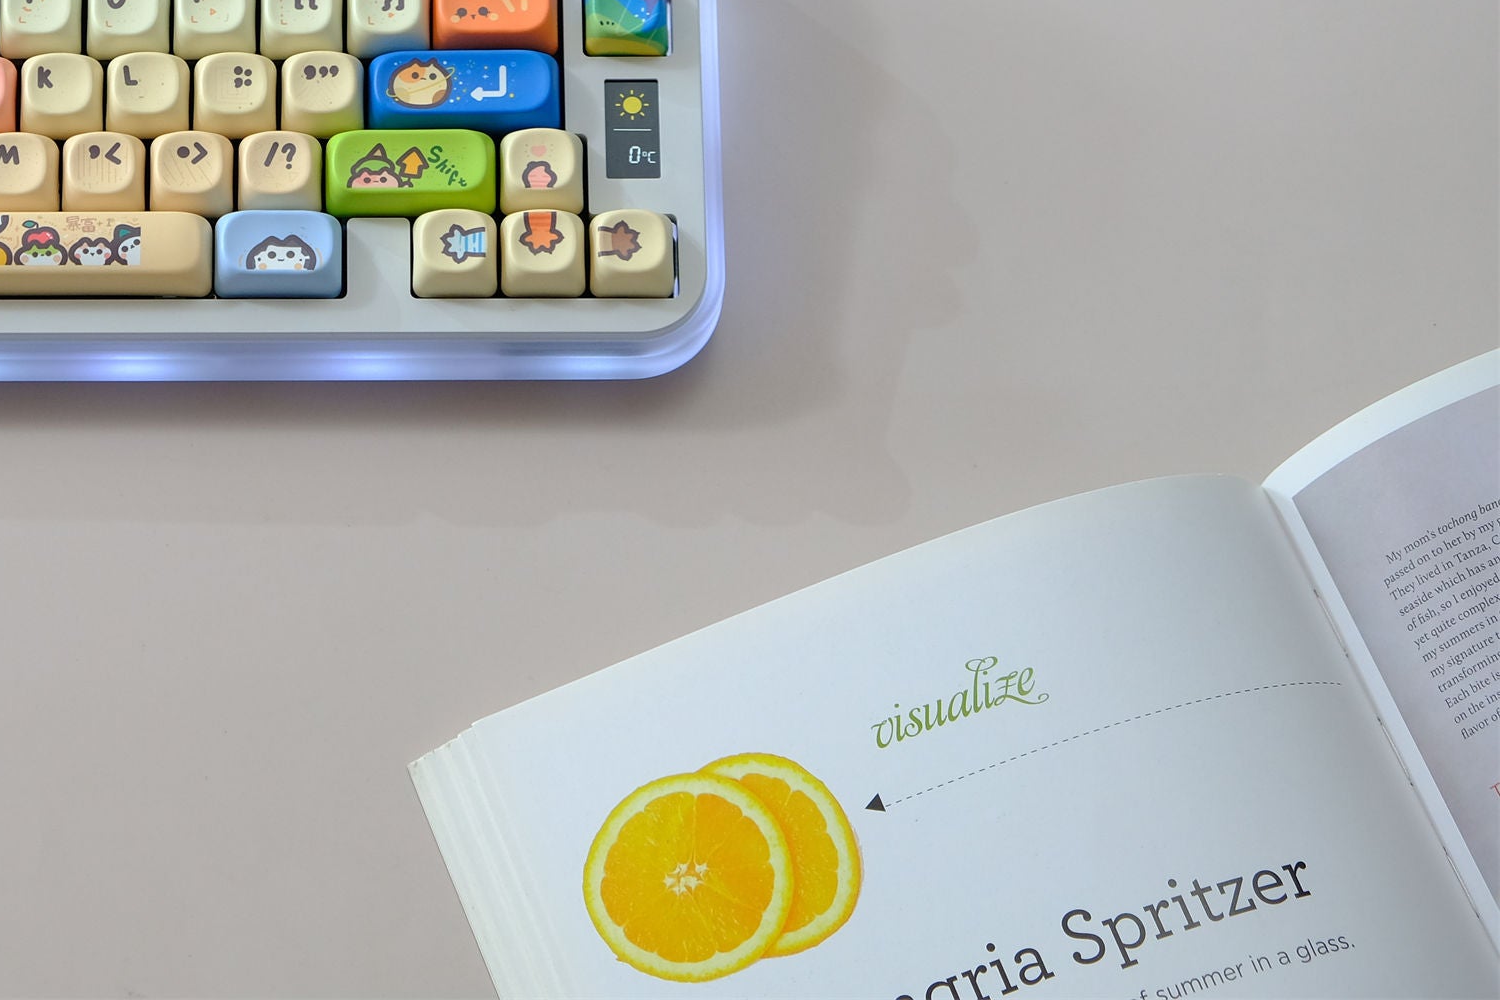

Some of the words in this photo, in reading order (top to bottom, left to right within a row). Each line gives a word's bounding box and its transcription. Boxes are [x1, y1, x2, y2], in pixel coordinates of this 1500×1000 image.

[37, 66, 53, 88] K
[124, 65, 138, 86] L
[427, 145, 468, 188] Shift
[1383, 559, 1416, 589] passed
[1417, 553, 1431, 566] on
[1431, 547, 1443, 557] to
[1443, 536, 1462, 551] her
[1461, 529, 1477, 541] by
[1478, 520, 1495, 534] my
[1385, 550, 1402, 564] My
[1404, 530, 1437, 553] mom's
[1437, 510, 1478, 535] tochong
[1390, 581, 1415, 601] They
[1415, 565, 1441, 586] lived
[1441, 560, 1454, 571] in
[1453, 544, 1492, 565] Tanza,
[1399, 591, 1434, 617] seaside
[1435, 572, 1467, 595] which
[1466, 563, 1487, 577] has
[1407, 617, 1417, 632] of
[1417, 608, 1440, 625] fish,
[1440, 600, 1452, 612] so
[1460, 572, 1500, 600] enjoyed
[1414, 632, 1431, 651] yet
[1430, 617, 1457, 638] quite
[1457, 594, 1500, 621] complex
[1422, 648, 1438, 663] my
[1439, 621, 1486, 652] summers
[1485, 615, 1499, 626] in
[1430, 664, 1445, 678] my
[1446, 636, 1495, 668] signature
[871, 656, 1049, 748] visualize
[1445, 688, 1470, 709] Each
[1469, 678, 1491, 693] bite
[1454, 712, 1468, 724] on
[1468, 702, 1485, 715] the
[1460, 718, 1489, 740] flavor
[1060, 859, 1312, 970] Spritzer
[1156, 962, 1244, 1000] summer
[1248, 952, 1273, 974] in
[1277, 951, 1292, 966] a
[1296, 935, 1356, 964] glass.
